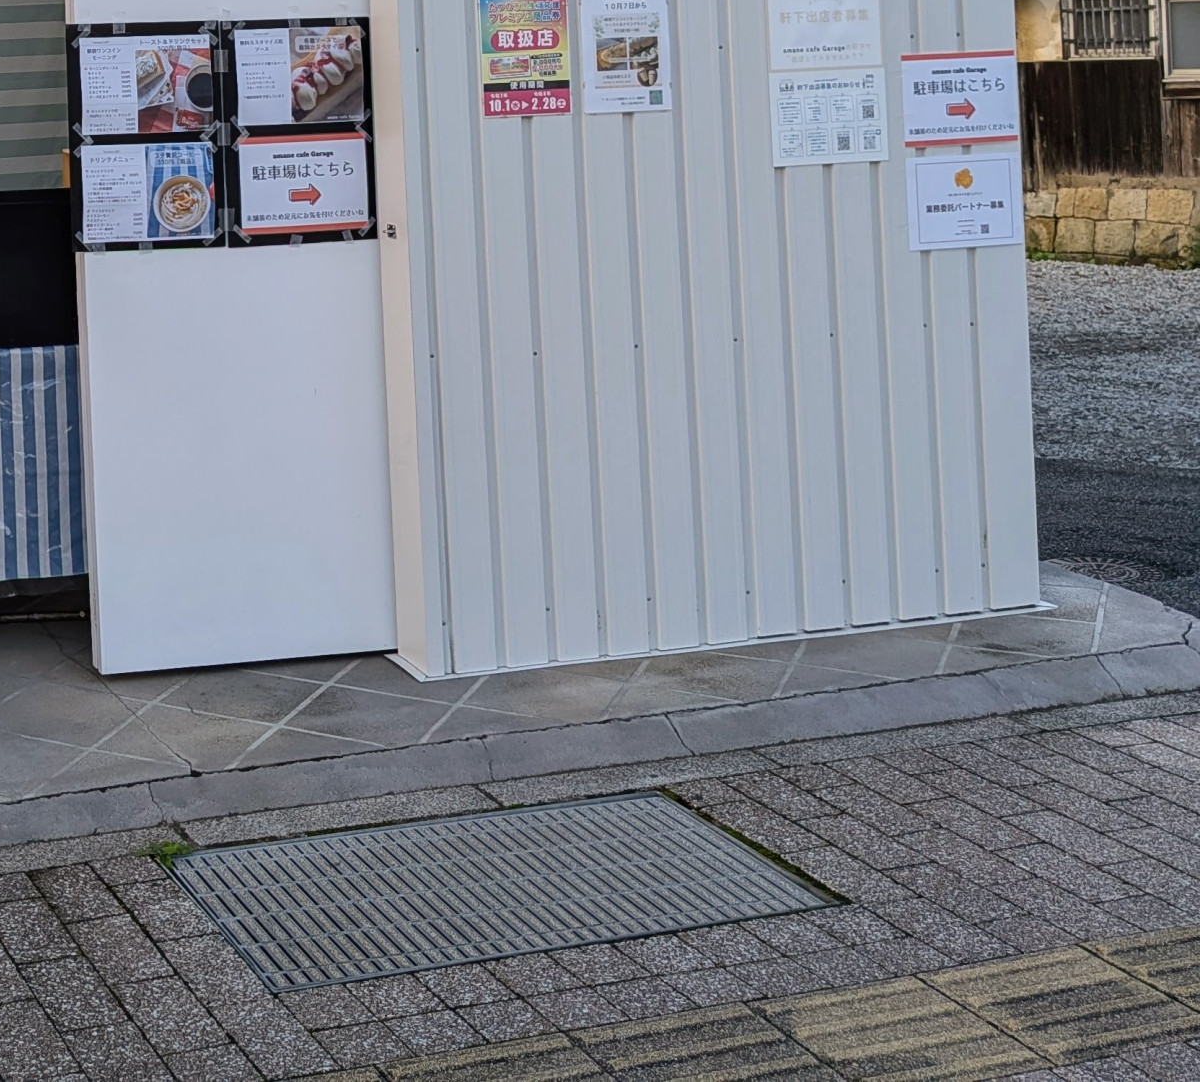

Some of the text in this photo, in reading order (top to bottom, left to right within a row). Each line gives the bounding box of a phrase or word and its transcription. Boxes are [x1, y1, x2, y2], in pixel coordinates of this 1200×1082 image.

[489, 10, 561, 23] プレミアム商品券
[498, 30, 553, 48] 取扱店
[510, 80, 544, 90] 使用期間
[913, 77, 1005, 96] 駐車場はこちら
[311, 150, 334, 158] Garage
[252, 161, 354, 180] 駐車場はこちら
[926, 200, 1005, 213] 業務委託パートナー募集
